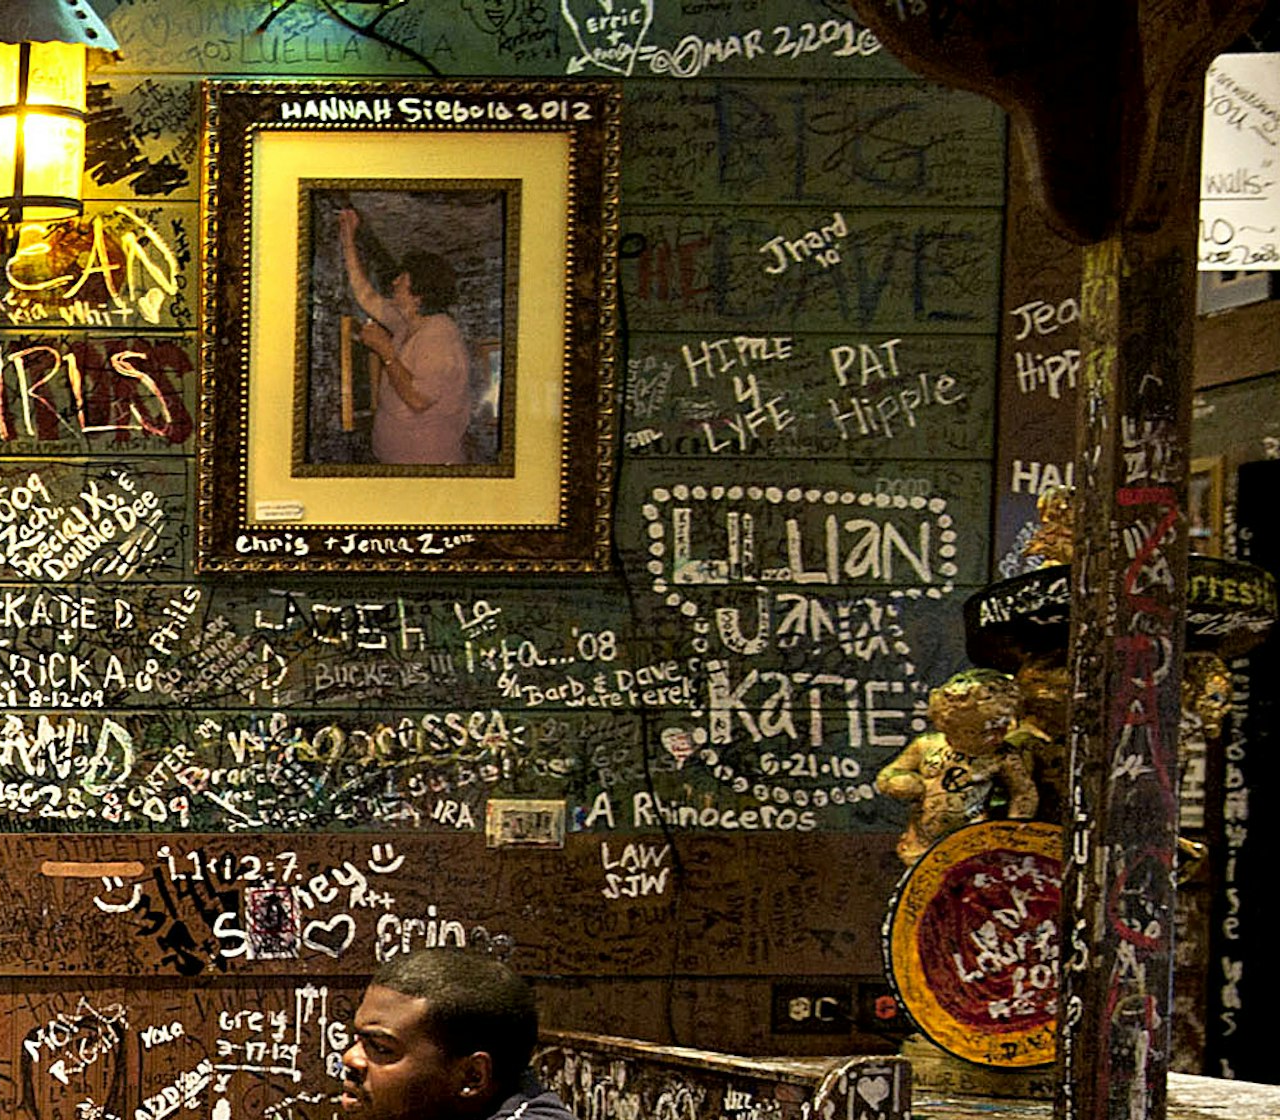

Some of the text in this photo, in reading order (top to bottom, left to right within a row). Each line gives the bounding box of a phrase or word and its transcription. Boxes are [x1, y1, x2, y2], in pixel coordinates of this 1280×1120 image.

[703, 28, 765, 67] MAR
[280, 96, 593, 123] HANNAH Siebold 2012
[829, 337, 902, 387] PAT
[702, 396, 795, 452] LYFE
[827, 372, 966, 441] Hipple
[42, 488, 161, 582] Double Dee
[235, 533, 311, 556] Chris
[27, 689, 105, 709] 8-12-09
[522, 675, 586, 707] Barb
[614, 658, 683, 692] Dave
[564, 691, 624, 708] were
[584, 790, 818, 832] A Rhinoceros
